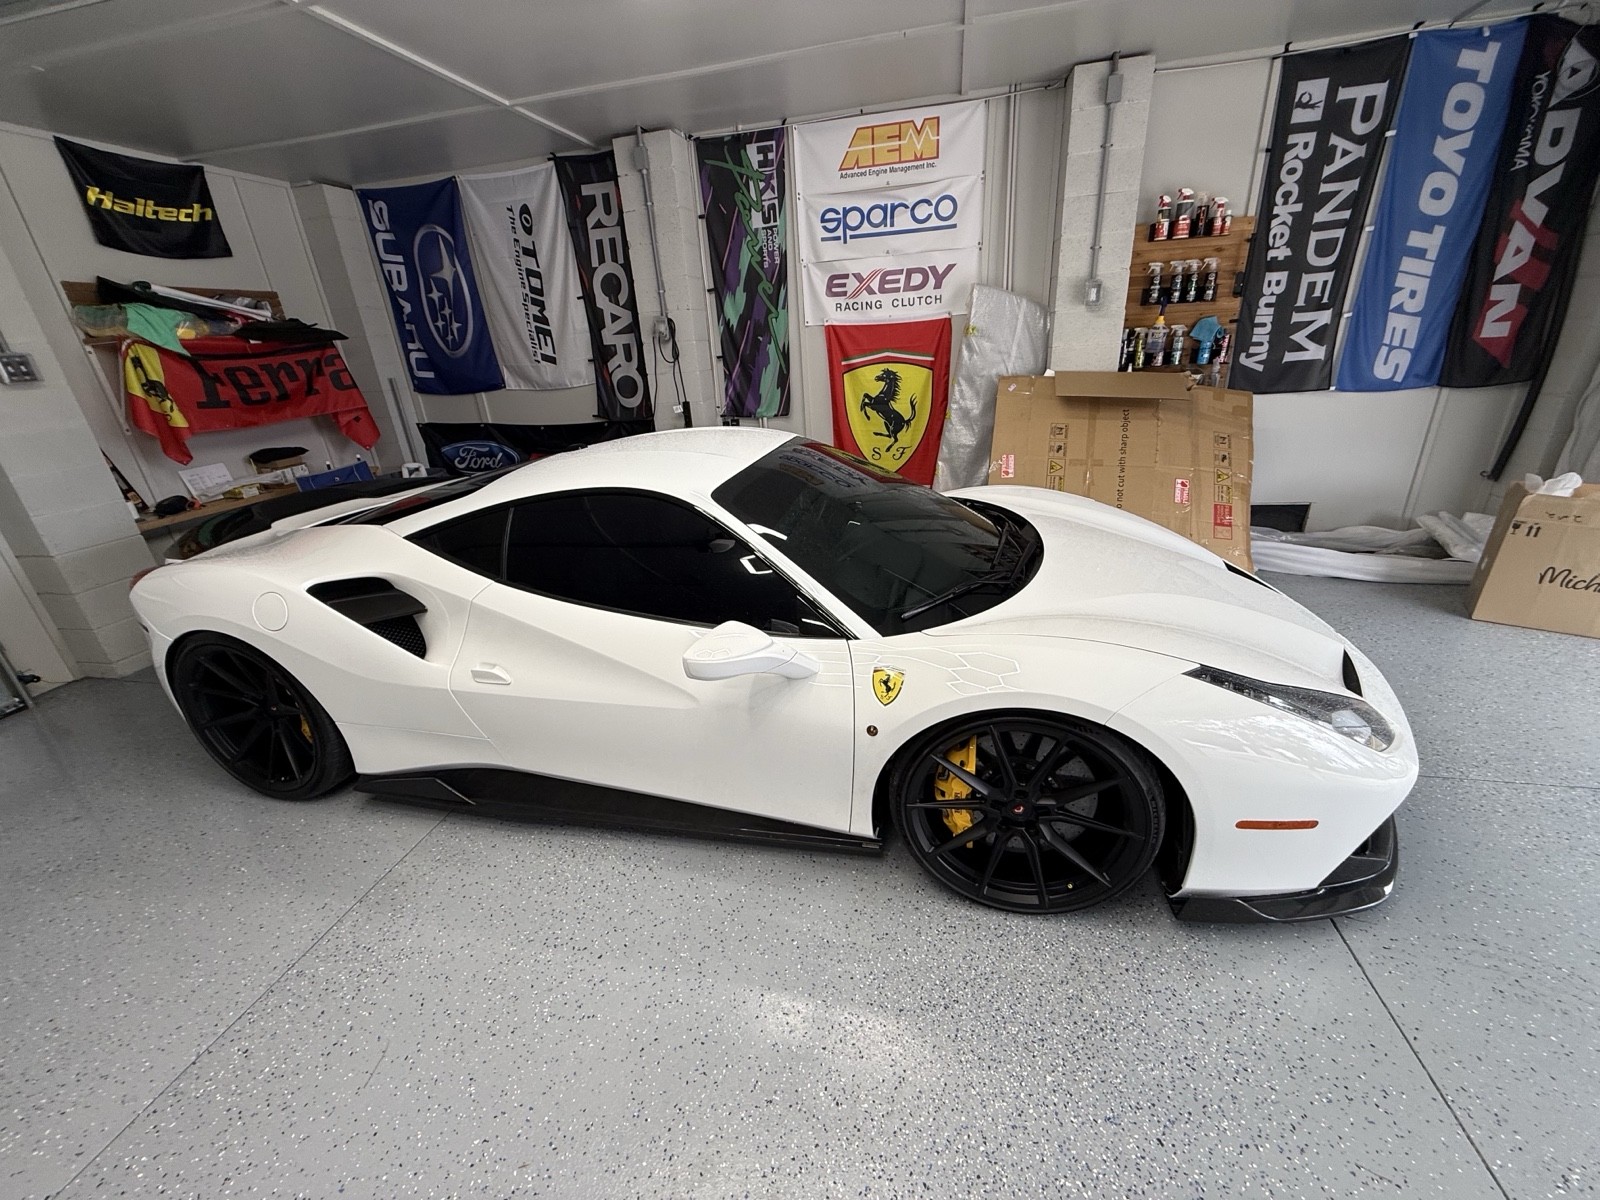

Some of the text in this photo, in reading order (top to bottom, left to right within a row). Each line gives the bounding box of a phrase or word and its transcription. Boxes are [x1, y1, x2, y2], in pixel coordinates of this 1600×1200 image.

[838, 116, 940, 171] AEM
[756, 144, 778, 226] HKS
[839, 161, 937, 180] Advanced Engine Management Inc.
[1480, 37, 1597, 339] ADVAN
[85, 184, 213, 223] Haltech
[820, 194, 958, 244] sparco
[1281, 79, 1390, 364] PANDEM
[1373, 41, 1501, 383] TOYO TIRES
[766, 229, 774, 251] AND
[772, 227, 780, 264] POWER
[1238, 130, 1318, 372] Rocket Bunny
[367, 199, 436, 379] SUBARU
[505, 204, 541, 365] The Engine Specialist
[580, 180, 644, 408] RECARO
[825, 263, 957, 300] EXEDY
[521, 240, 558, 366] TOMEI
[835, 294, 943, 312] RACING CLUTCH
[1120, 409, 1131, 433] object
[454, 444, 503, 469] Ford
[872, 447, 882, 460] S
[1118, 433, 1129, 455] sharp
[1117, 456, 1126, 473] with
[1117, 475, 1125, 488] cut
[1116, 489, 1124, 502] not
[1538, 566, 1600, 593] Mich
